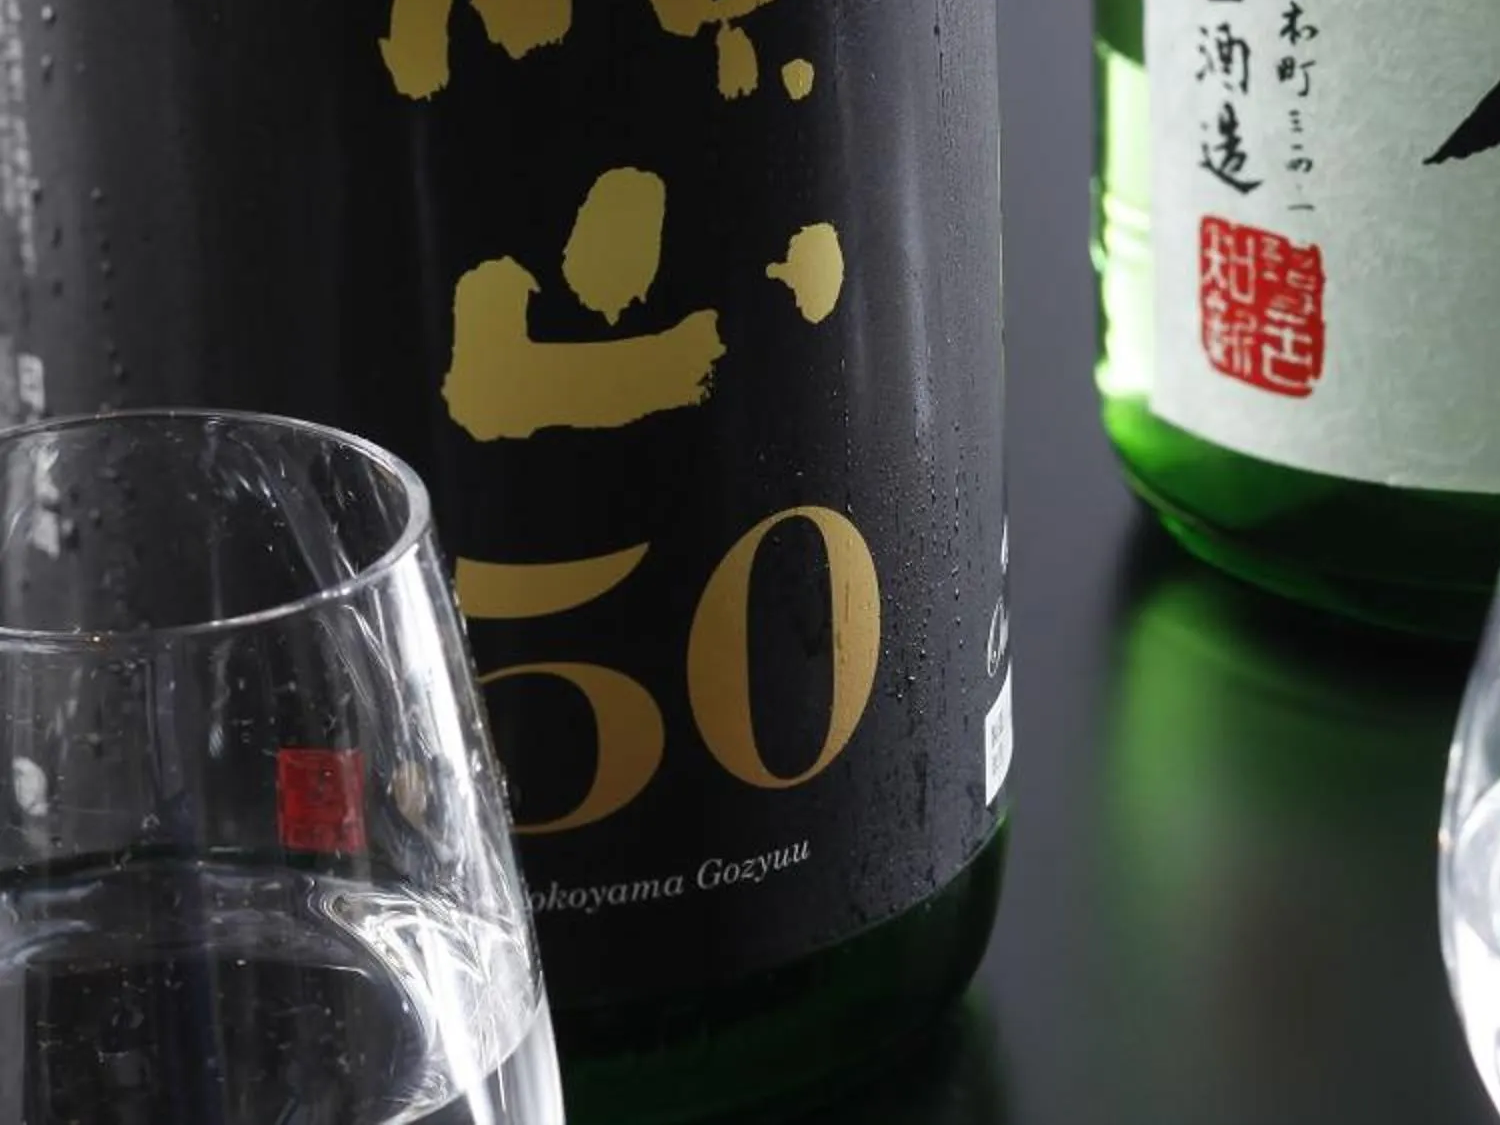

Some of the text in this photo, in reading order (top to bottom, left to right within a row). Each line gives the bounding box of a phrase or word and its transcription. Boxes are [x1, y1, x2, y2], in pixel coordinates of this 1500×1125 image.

[454, 504, 882, 835] 50
[524, 838, 811, 916] okoyama Gozyuu
